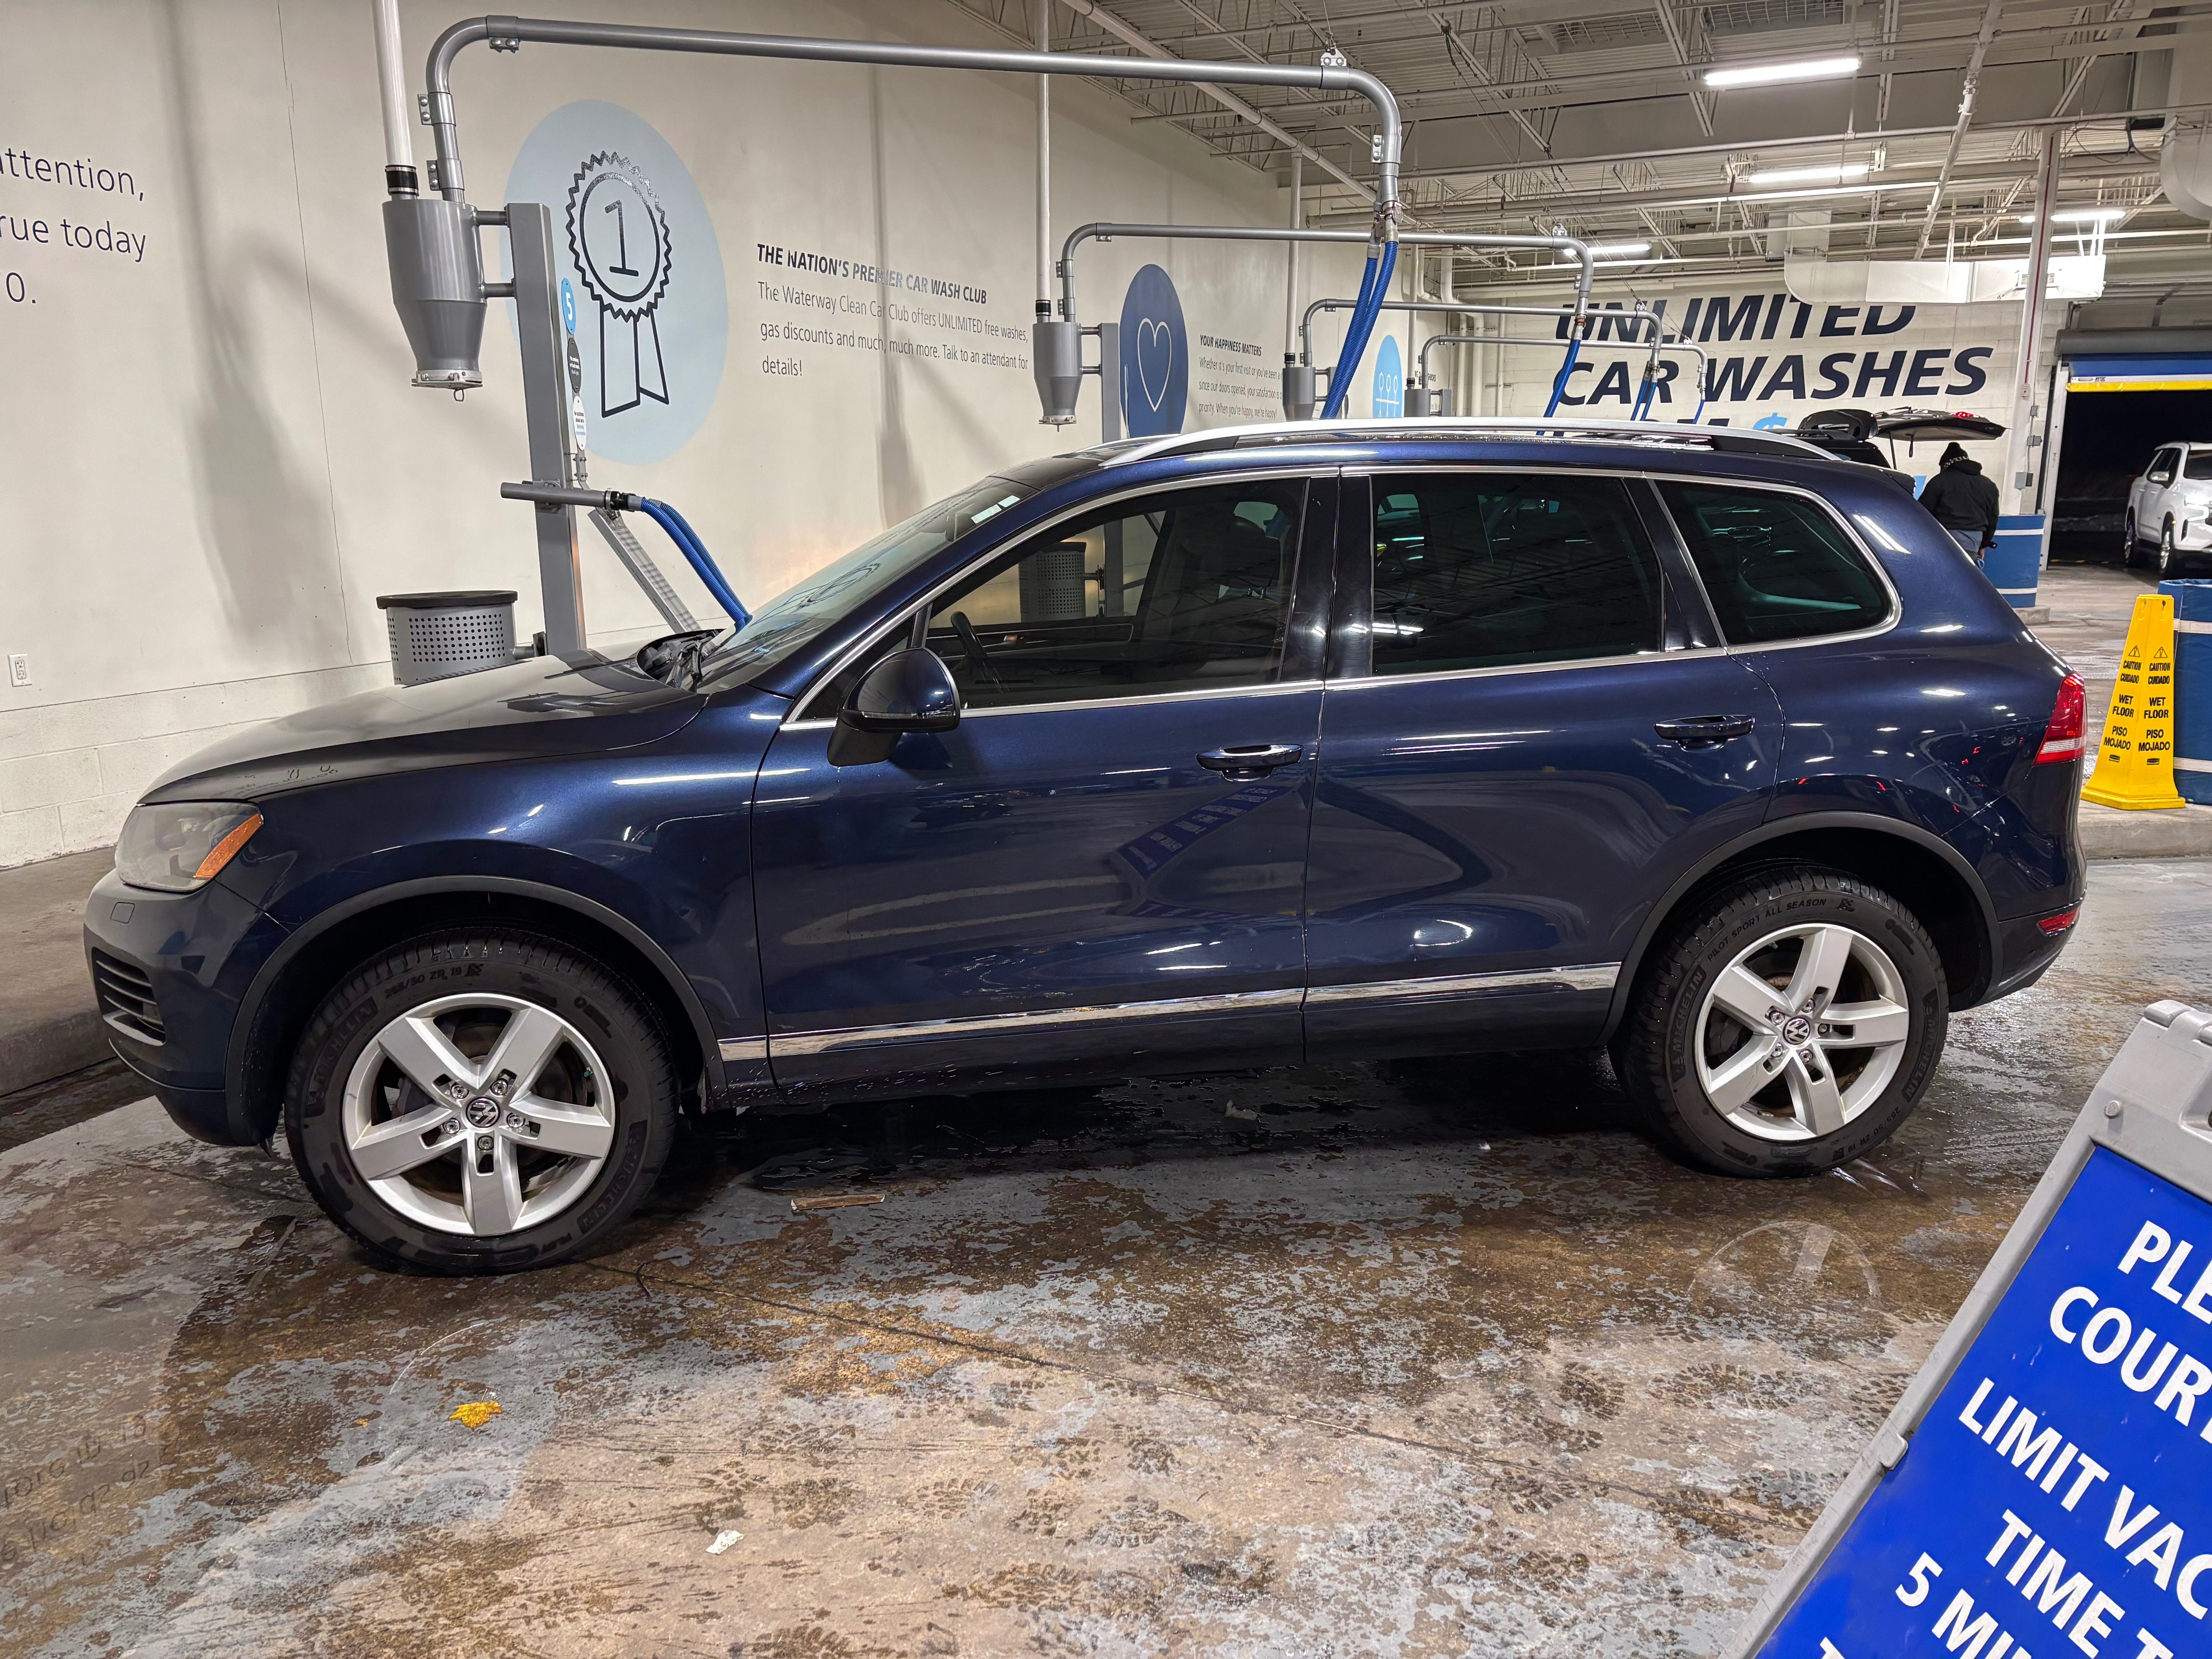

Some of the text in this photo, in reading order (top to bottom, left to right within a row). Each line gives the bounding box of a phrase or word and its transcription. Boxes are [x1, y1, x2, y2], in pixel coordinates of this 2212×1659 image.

[0, 148, 143, 201] ttention,
[60, 219, 146, 263] today
[757, 244, 987, 304] THE NATION'S PREMIER CAR WASH CLUB
[565, 293, 573, 321] 5
[758, 281, 1028, 343] The Waterway Clean Car Club offers UNLIMITED free washes,
[1556, 293, 1915, 342] UNLIMITED
[761, 321, 1028, 369] gas discounts and much, much more. Talk to an attendant for
[1200, 335, 1261, 356] YOUR HAPPINESS MATTERS
[763, 355, 802, 376] details!
[1200, 357, 1217, 369] Whether
[1226, 364, 1234, 374] your
[1269, 368, 1277, 378] been
[1553, 347, 1994, 405] CAR WASHES
[1199, 381, 1209, 391] since
[1219, 381, 1230, 393] doors
[1231, 384, 1246, 396] opened,
[1247, 388, 1255, 398] your
[1256, 387, 1275, 398] satisfaction
[1199, 402, 1215, 415] priority.
[1216, 402, 1228, 414] When
[2123, 660, 2142, 671] CAUTION
[2149, 663, 2170, 671] CAUTION
[2120, 673, 2139, 684] CUIDADO
[2148, 676, 2170, 685] CUIDADO
[2119, 694, 2133, 705] WET
[2149, 697, 2166, 706] WET
[2112, 706, 2134, 718] FLOOR
[2144, 709, 2169, 719] FLOOR
[2112, 725, 2127, 737] PISO
[2146, 729, 2164, 739] PISO
[2104, 737, 2131, 750] MOJADO
[2138, 742, 2170, 751] MOJADO
[1707, 898, 1827, 962] PILOT SPORT ALL SEASON
[1673, 970, 1703, 1052] MICHELIN
[2050, 1286, 2212, 1444] COUR
[1958, 1377, 2212, 1620] LIMIT VAC
[1985, 1509, 2125, 1659] TIME
[1896, 1552, 2032, 1659] 5 MI
